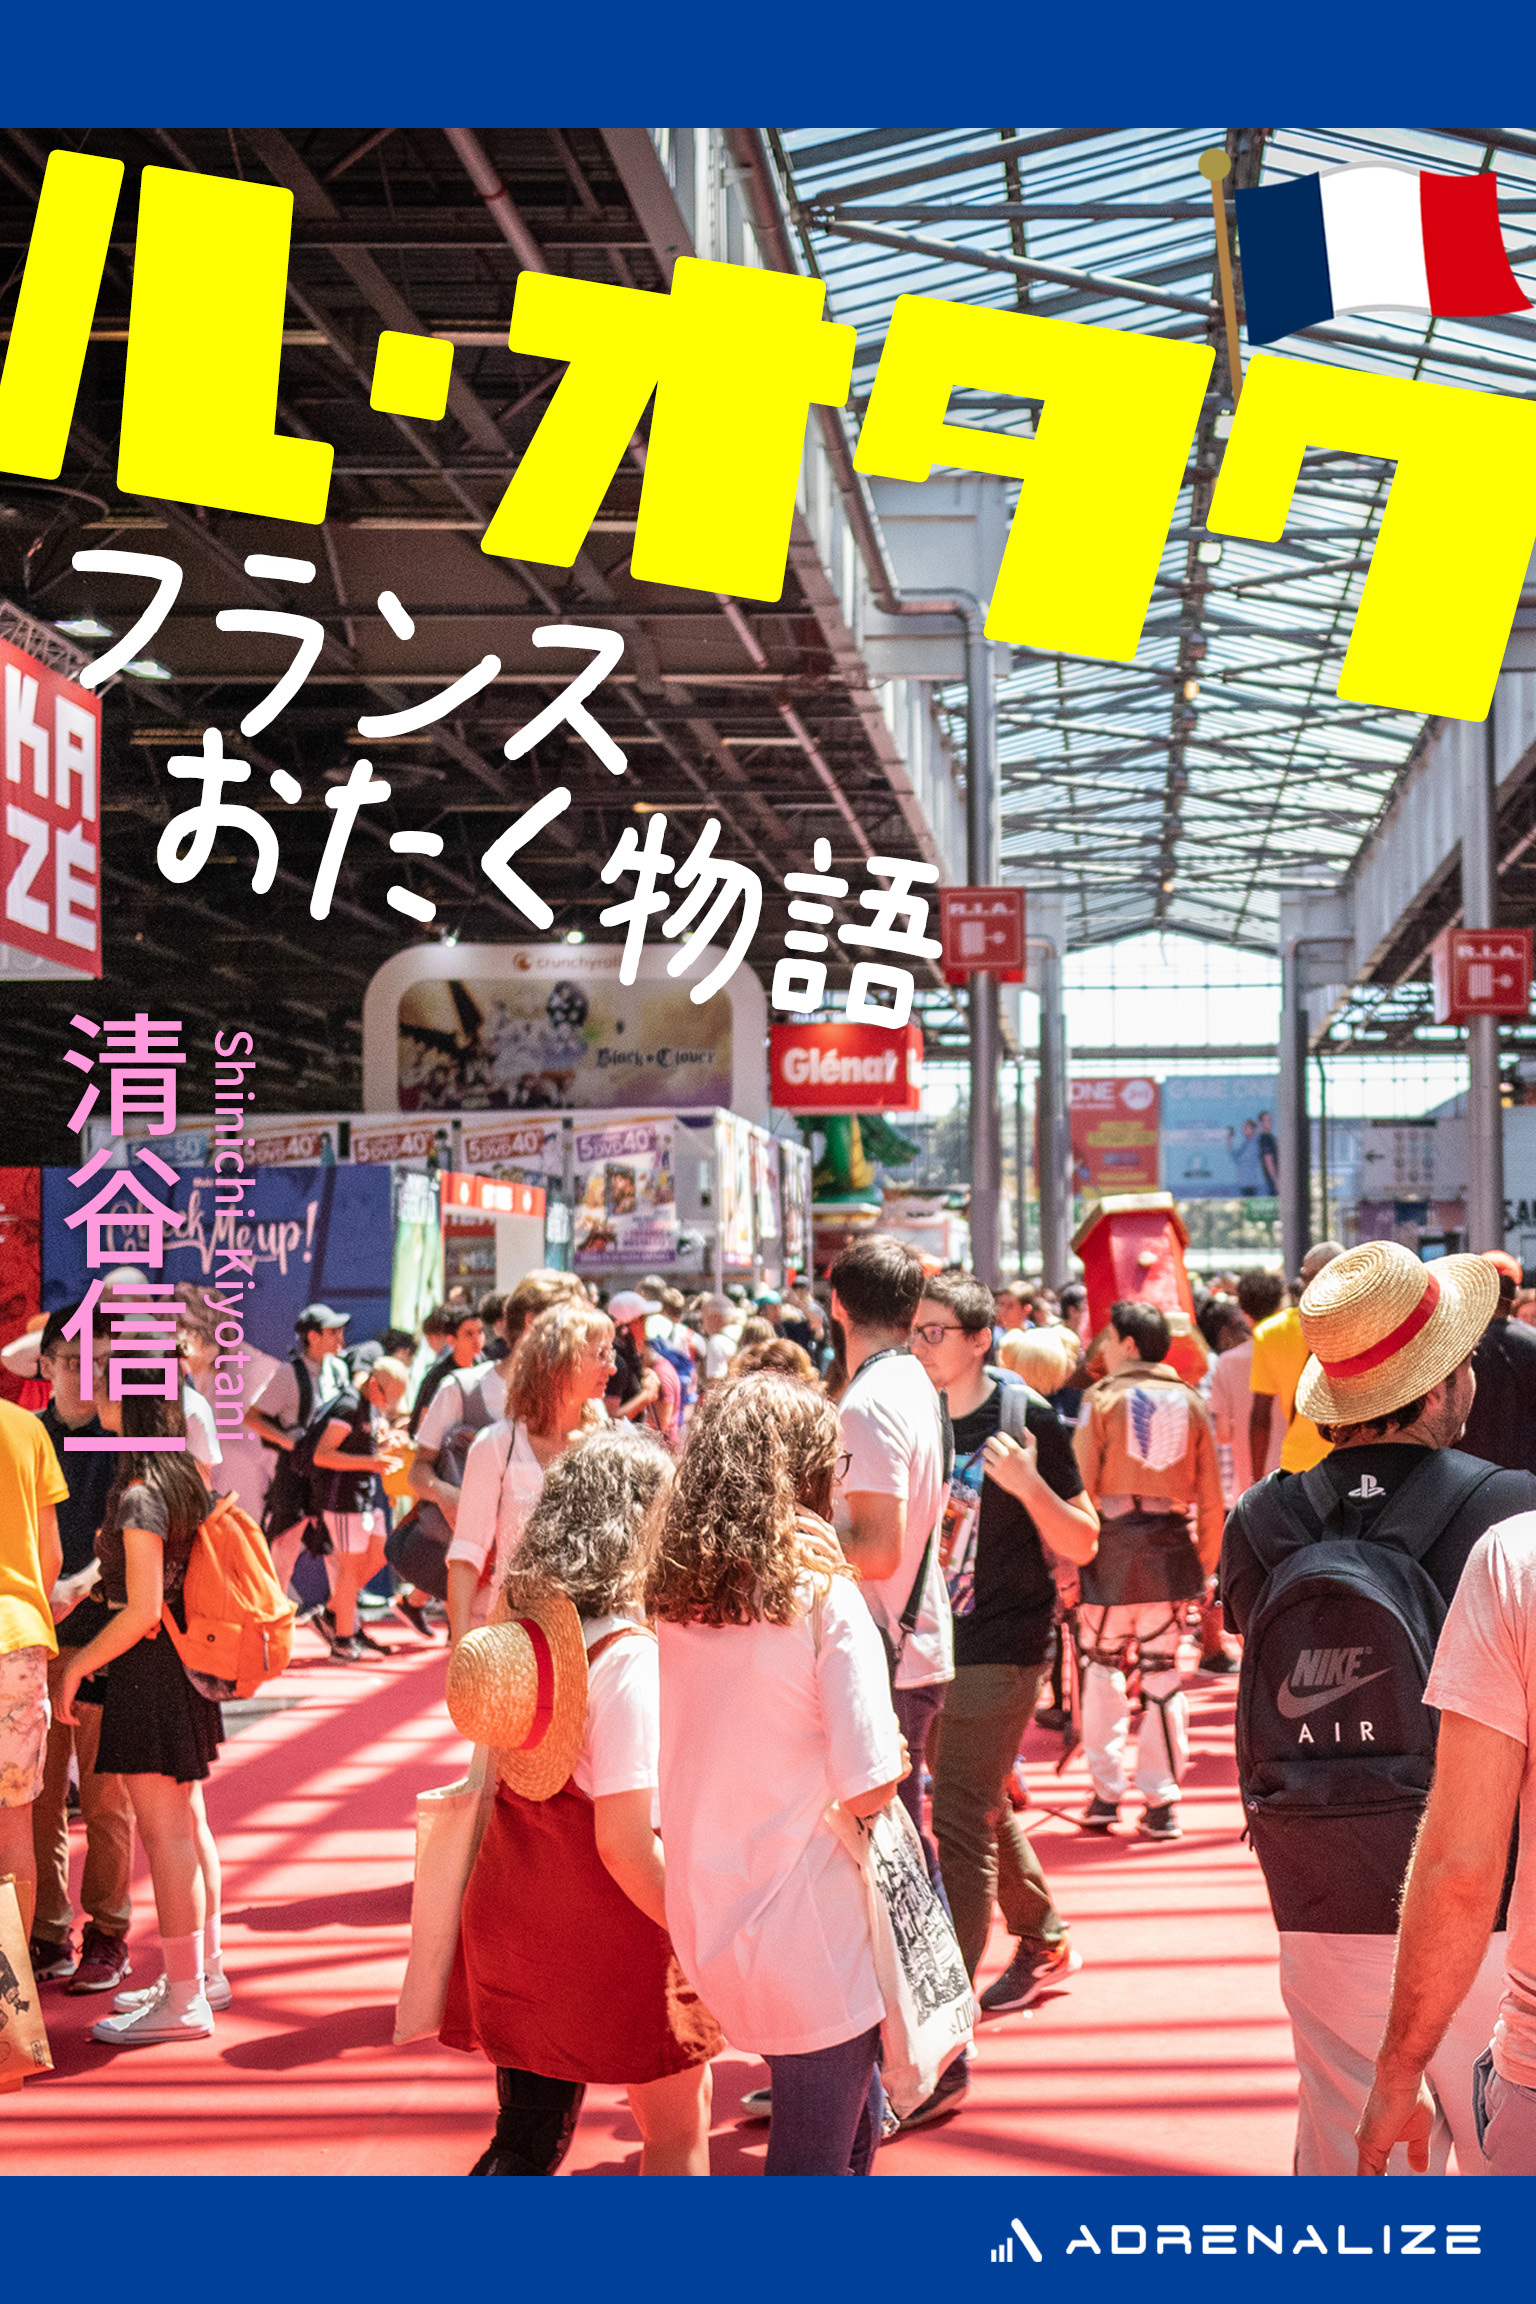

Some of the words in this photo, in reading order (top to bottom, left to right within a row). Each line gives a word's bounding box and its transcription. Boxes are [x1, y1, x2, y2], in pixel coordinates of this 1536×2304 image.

[781, 1047, 898, 1085] Glénat
[1291, 1647, 1365, 1687] NIKE
[1298, 1720, 1376, 1744] AIR
